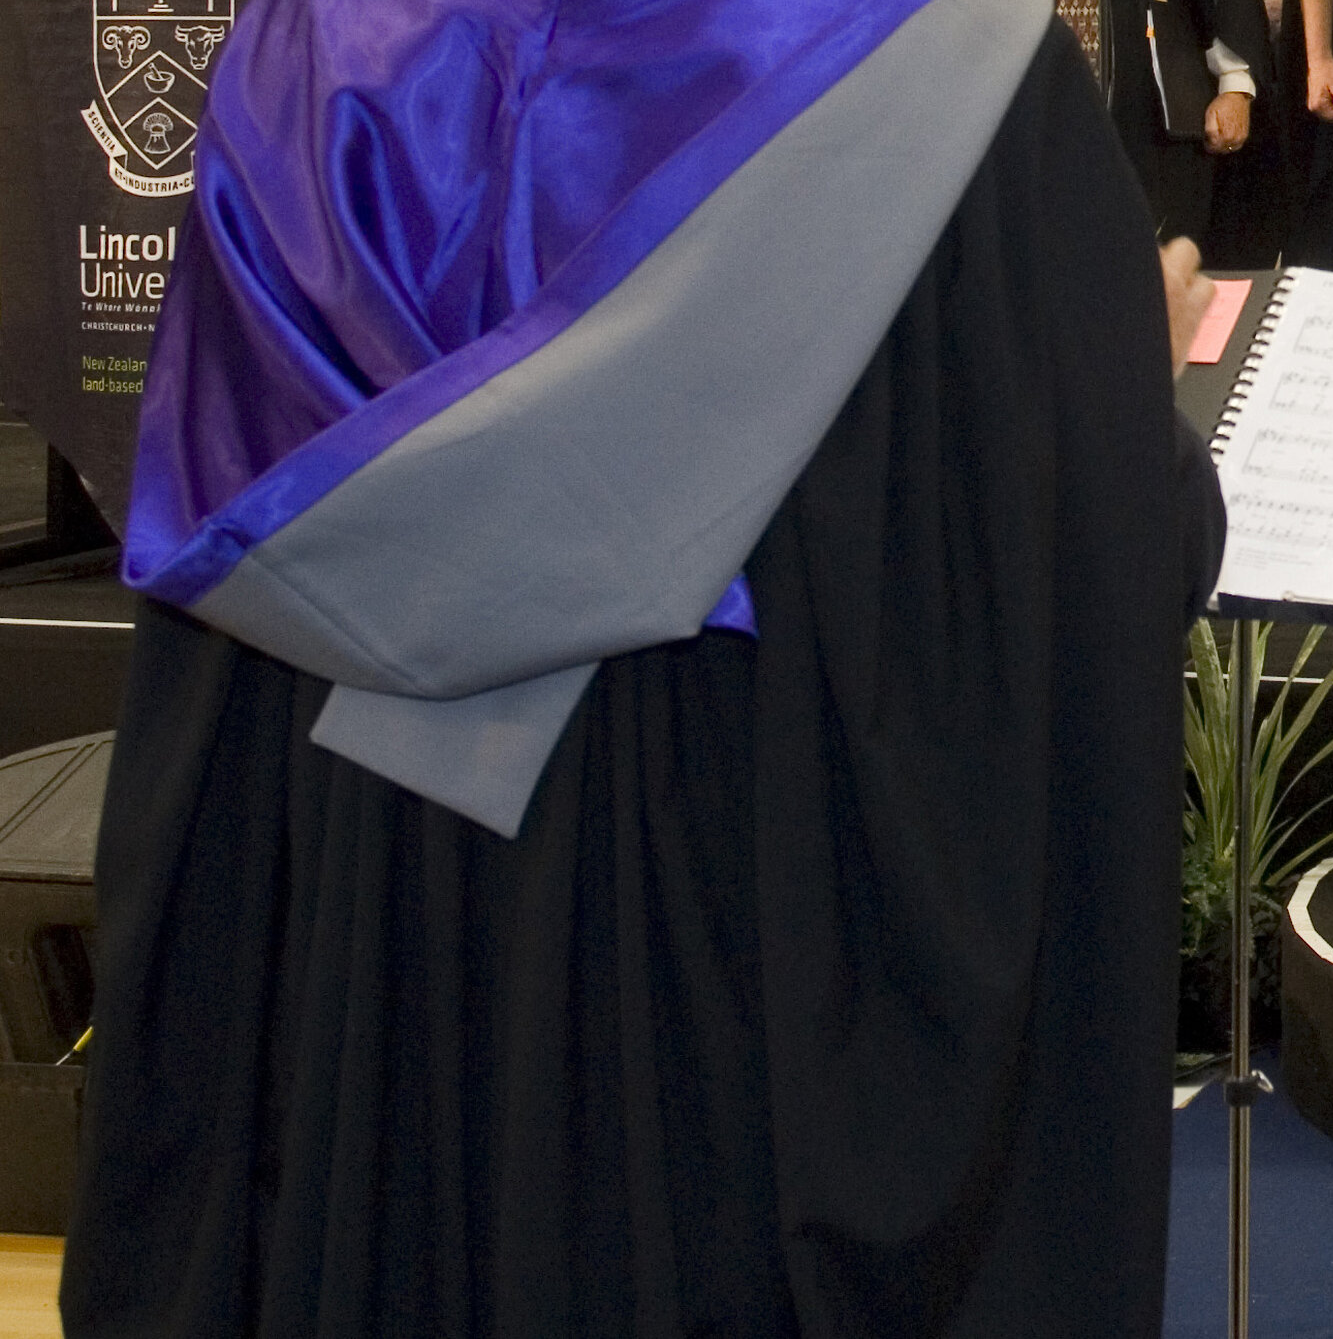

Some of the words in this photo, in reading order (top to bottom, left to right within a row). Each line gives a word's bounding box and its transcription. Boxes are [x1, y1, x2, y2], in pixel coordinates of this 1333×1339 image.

[88, 111, 116, 152] SCIENTIA
[79, 224, 176, 262] Lincol
[80, 262, 165, 299] Unive
[81, 301, 92, 311] Te
[82, 355, 106, 371] New
[107, 356, 148, 373] Zealan
[82, 376, 144, 394] land-based
